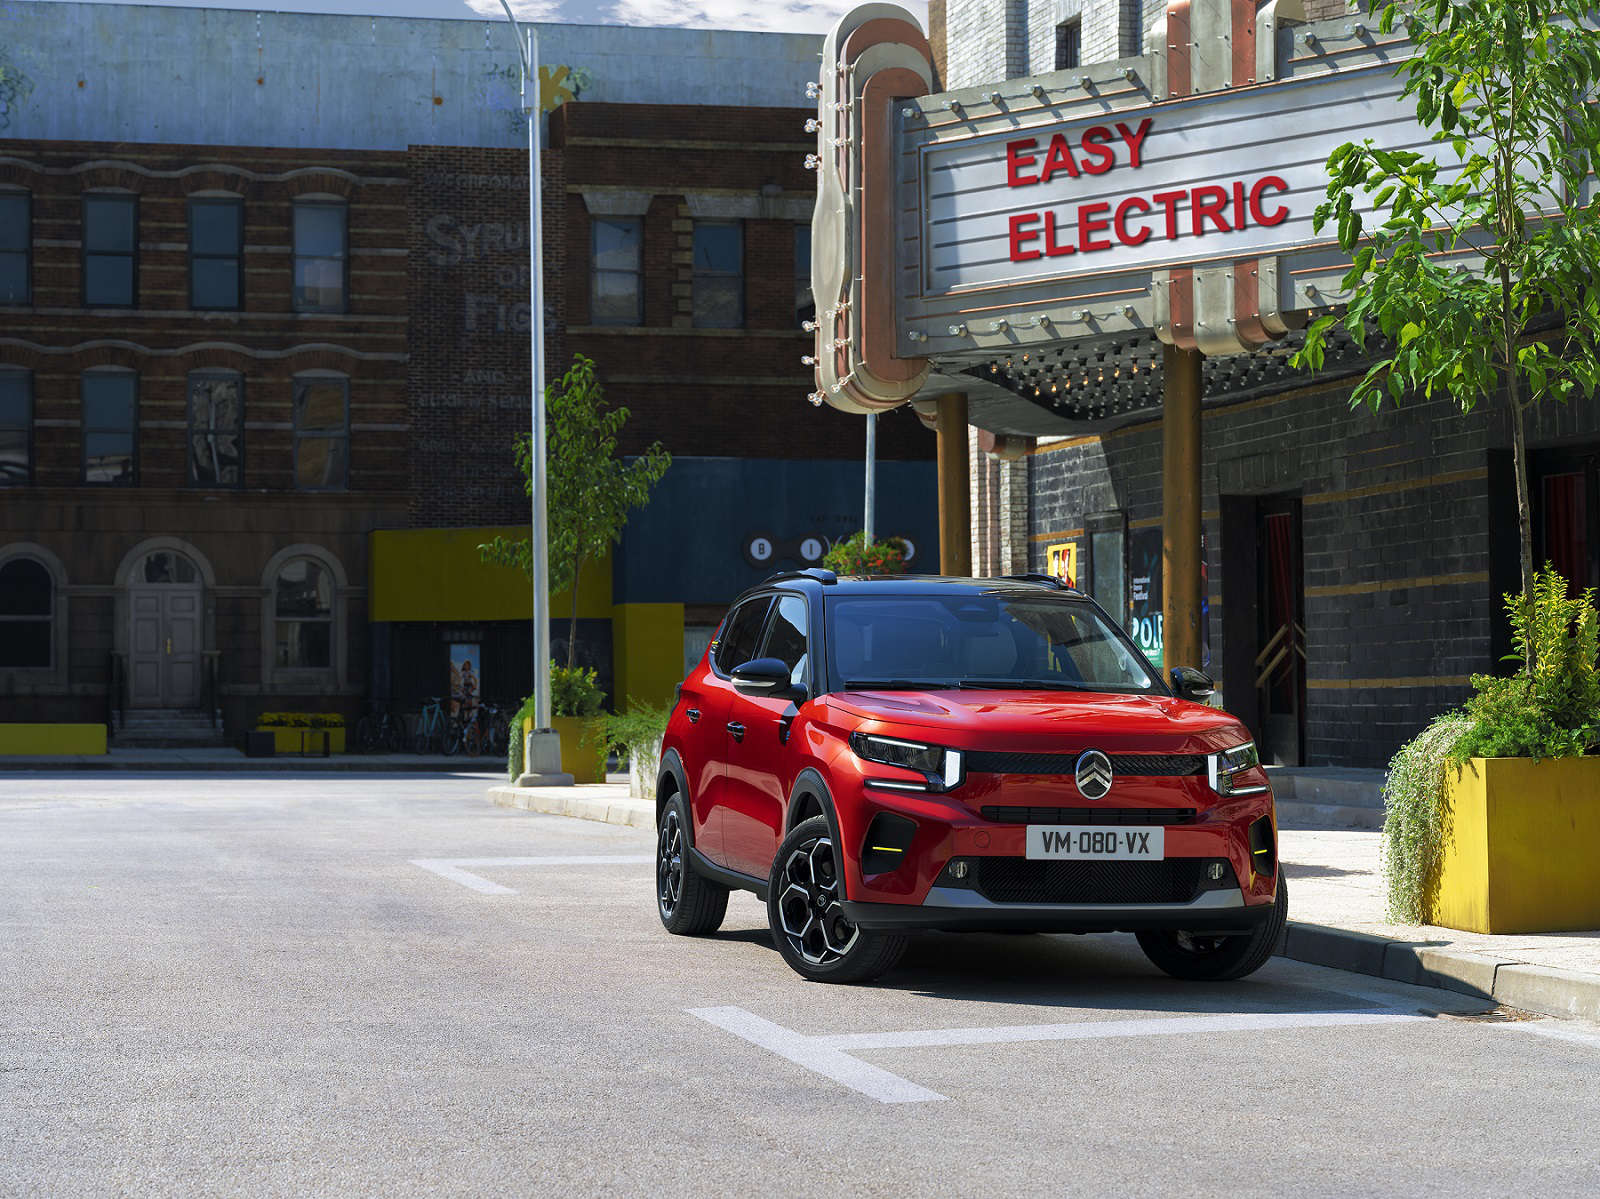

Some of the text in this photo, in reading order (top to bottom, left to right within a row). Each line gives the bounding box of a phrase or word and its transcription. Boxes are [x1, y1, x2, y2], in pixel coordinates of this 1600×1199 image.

[1006, 117, 1153, 188] EASY
[425, 213, 530, 266] SYRU
[1008, 175, 1289, 262] ELECTRIC
[1042, 831, 1150, 854] VM-080-VX
